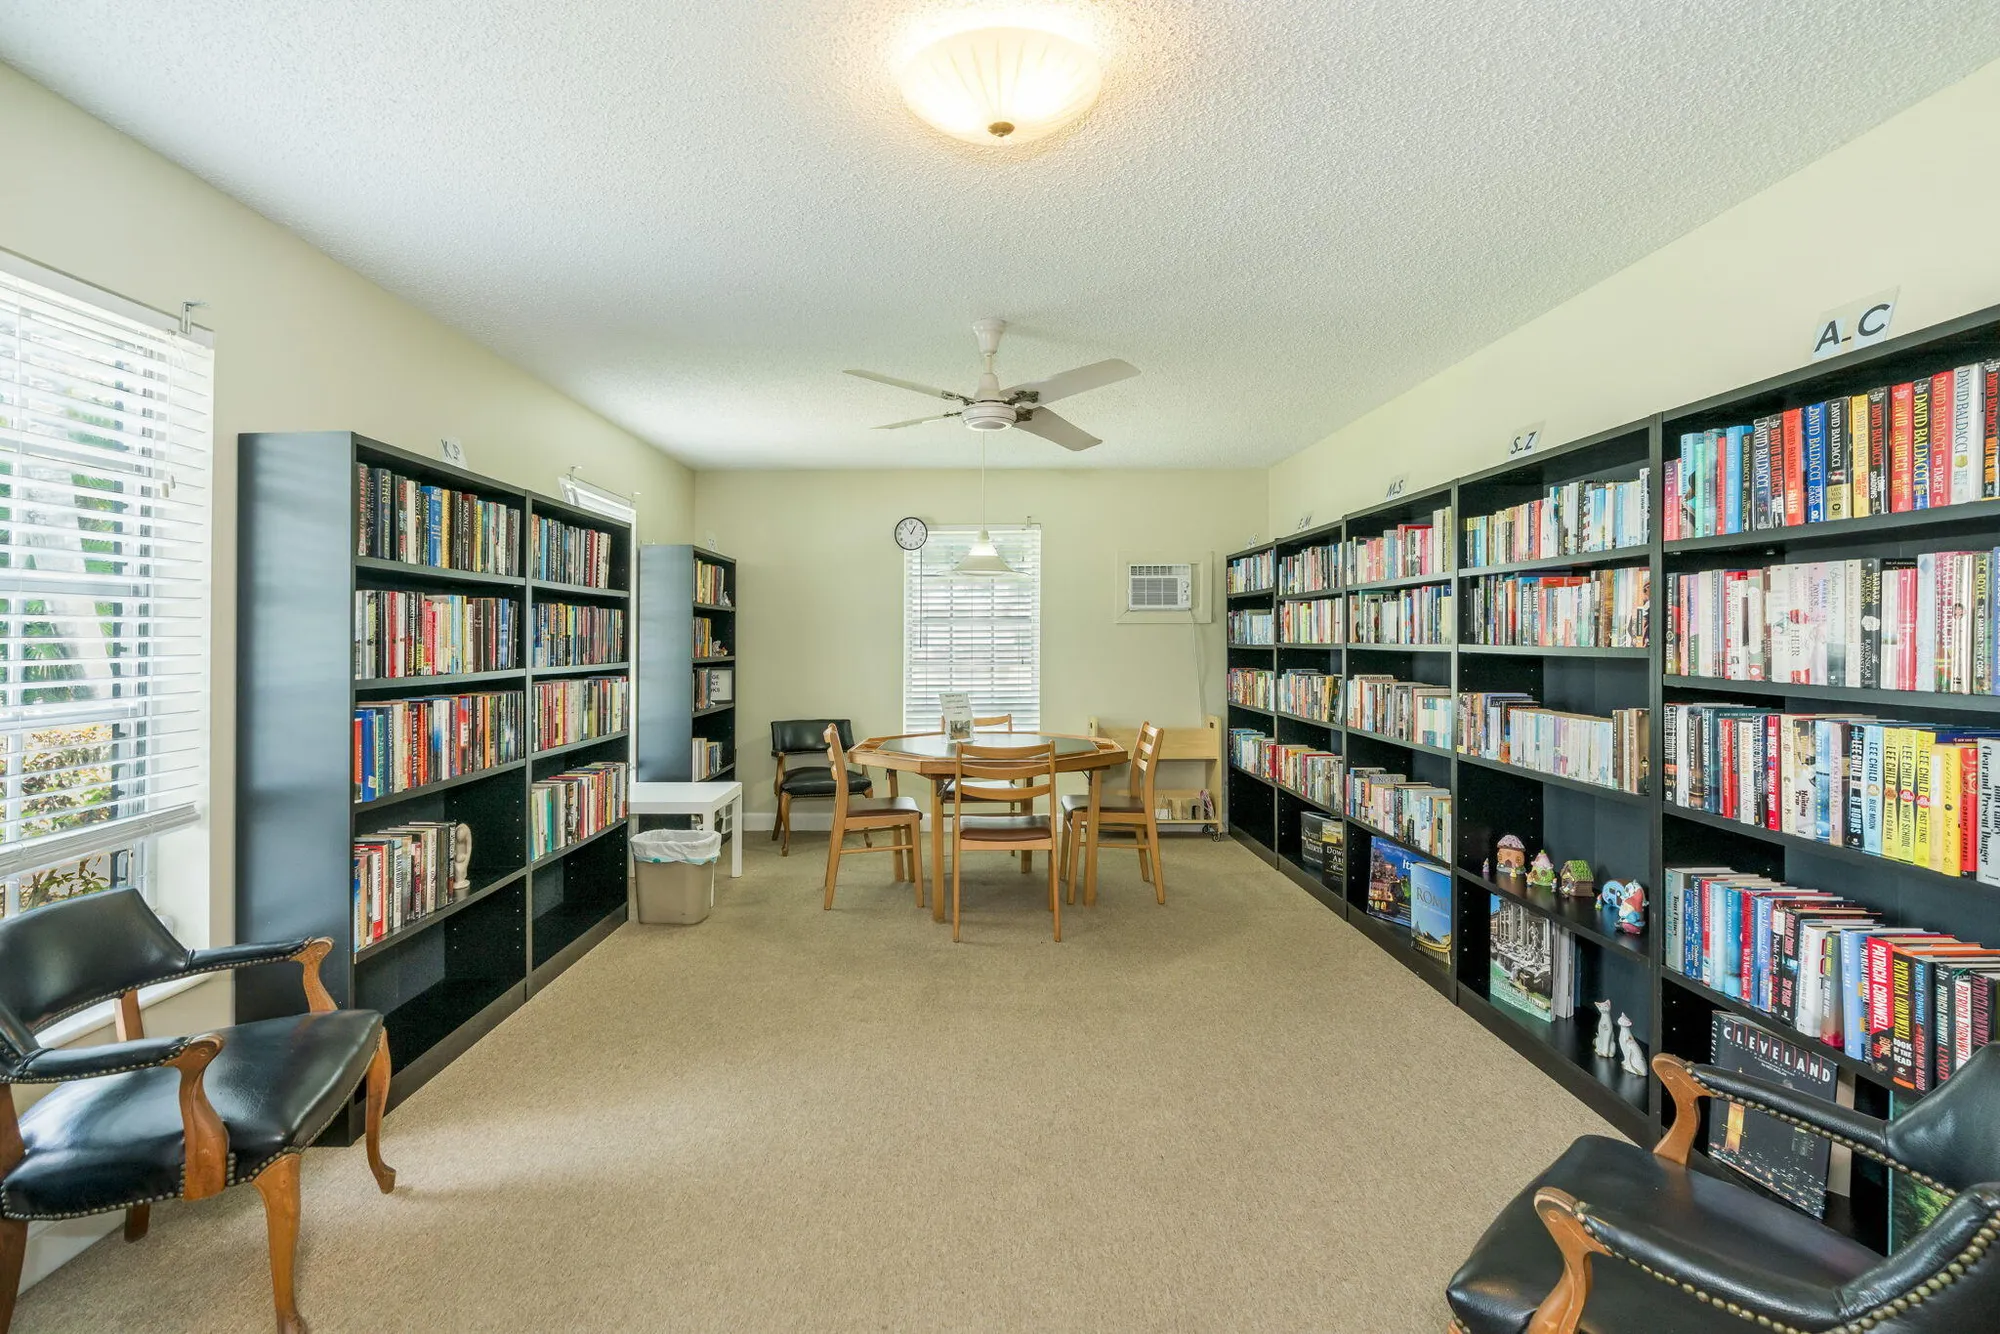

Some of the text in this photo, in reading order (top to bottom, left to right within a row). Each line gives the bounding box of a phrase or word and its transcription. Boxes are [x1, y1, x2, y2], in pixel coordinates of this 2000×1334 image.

[1934, 377, 1946, 405] DAVID
[1986, 372, 1998, 435] DAVID BALDACCI
[1955, 369, 1970, 453] DAVID BALDACCI
[1808, 407, 1821, 481] DAVID BALDACCI
[1832, 403, 1841, 467] DAVID BALDACCI
[1856, 410, 1865, 467] DAVID BALDACCI
[1872, 404, 1882, 466] DAVID BALDACCI
[1894, 400, 1908, 472] DAVID BALDACCI
[1914, 393, 1928, 481] DAVID BALDACCI
[1933, 407, 1945, 451] BALDACCI
[1754, 420, 1768, 488] DAVID BALDACCI
[1770, 428, 1782, 495] DAVID BALDACCI
[1787, 426, 1797, 479] DAVID BALDACCI
[1934, 467, 1943, 493] TARGET
[1977, 573, 1986, 599] BOYLE
[1791, 629, 1800, 656] HEIR
[1851, 740, 1862, 756] LEE
[1869, 742, 1878, 757] LEE
[1886, 746, 1895, 761] LEE
[1851, 756, 1861, 777] CHILD
[1869, 759, 1878, 781] CHILD
[1886, 764, 1895, 785] CHILD
[1902, 764, 1912, 786] CHILD
[1850, 808, 1862, 833] HOURS
[1868, 813, 1876, 830] MOON
[1903, 804, 1911, 822] NIGHT
[1980, 746, 1991, 865] Clear and Present Danger
[1902, 824, 1911, 847] SCHOOL
[1761, 944, 1770, 963] Clark
[1782, 913, 1795, 1007] HARLAN COBEN SIX YEARS
[1873, 944, 1888, 1029] PATRICIA CORNWELL
[1915, 963, 1924, 990] PATRICIA
[1894, 959, 1910, 1040] PATRICIA CORNWELL
[1915, 992, 1924, 1024] CORNWELL
[1973, 976, 1989, 1047] PATRICIA CORNWELL
[1937, 985, 1949, 1080] PATRICIA CORNWELL LIVID
[1956, 984, 1969, 1062] PATRICIA CORNWELL
[1723, 1026, 1831, 1083] CLEVELAND
[1893, 1053, 1912, 1067] DEAD
[1916, 1034, 1924, 1054] FLESH
[1916, 1069, 1925, 1090] BLOOD
